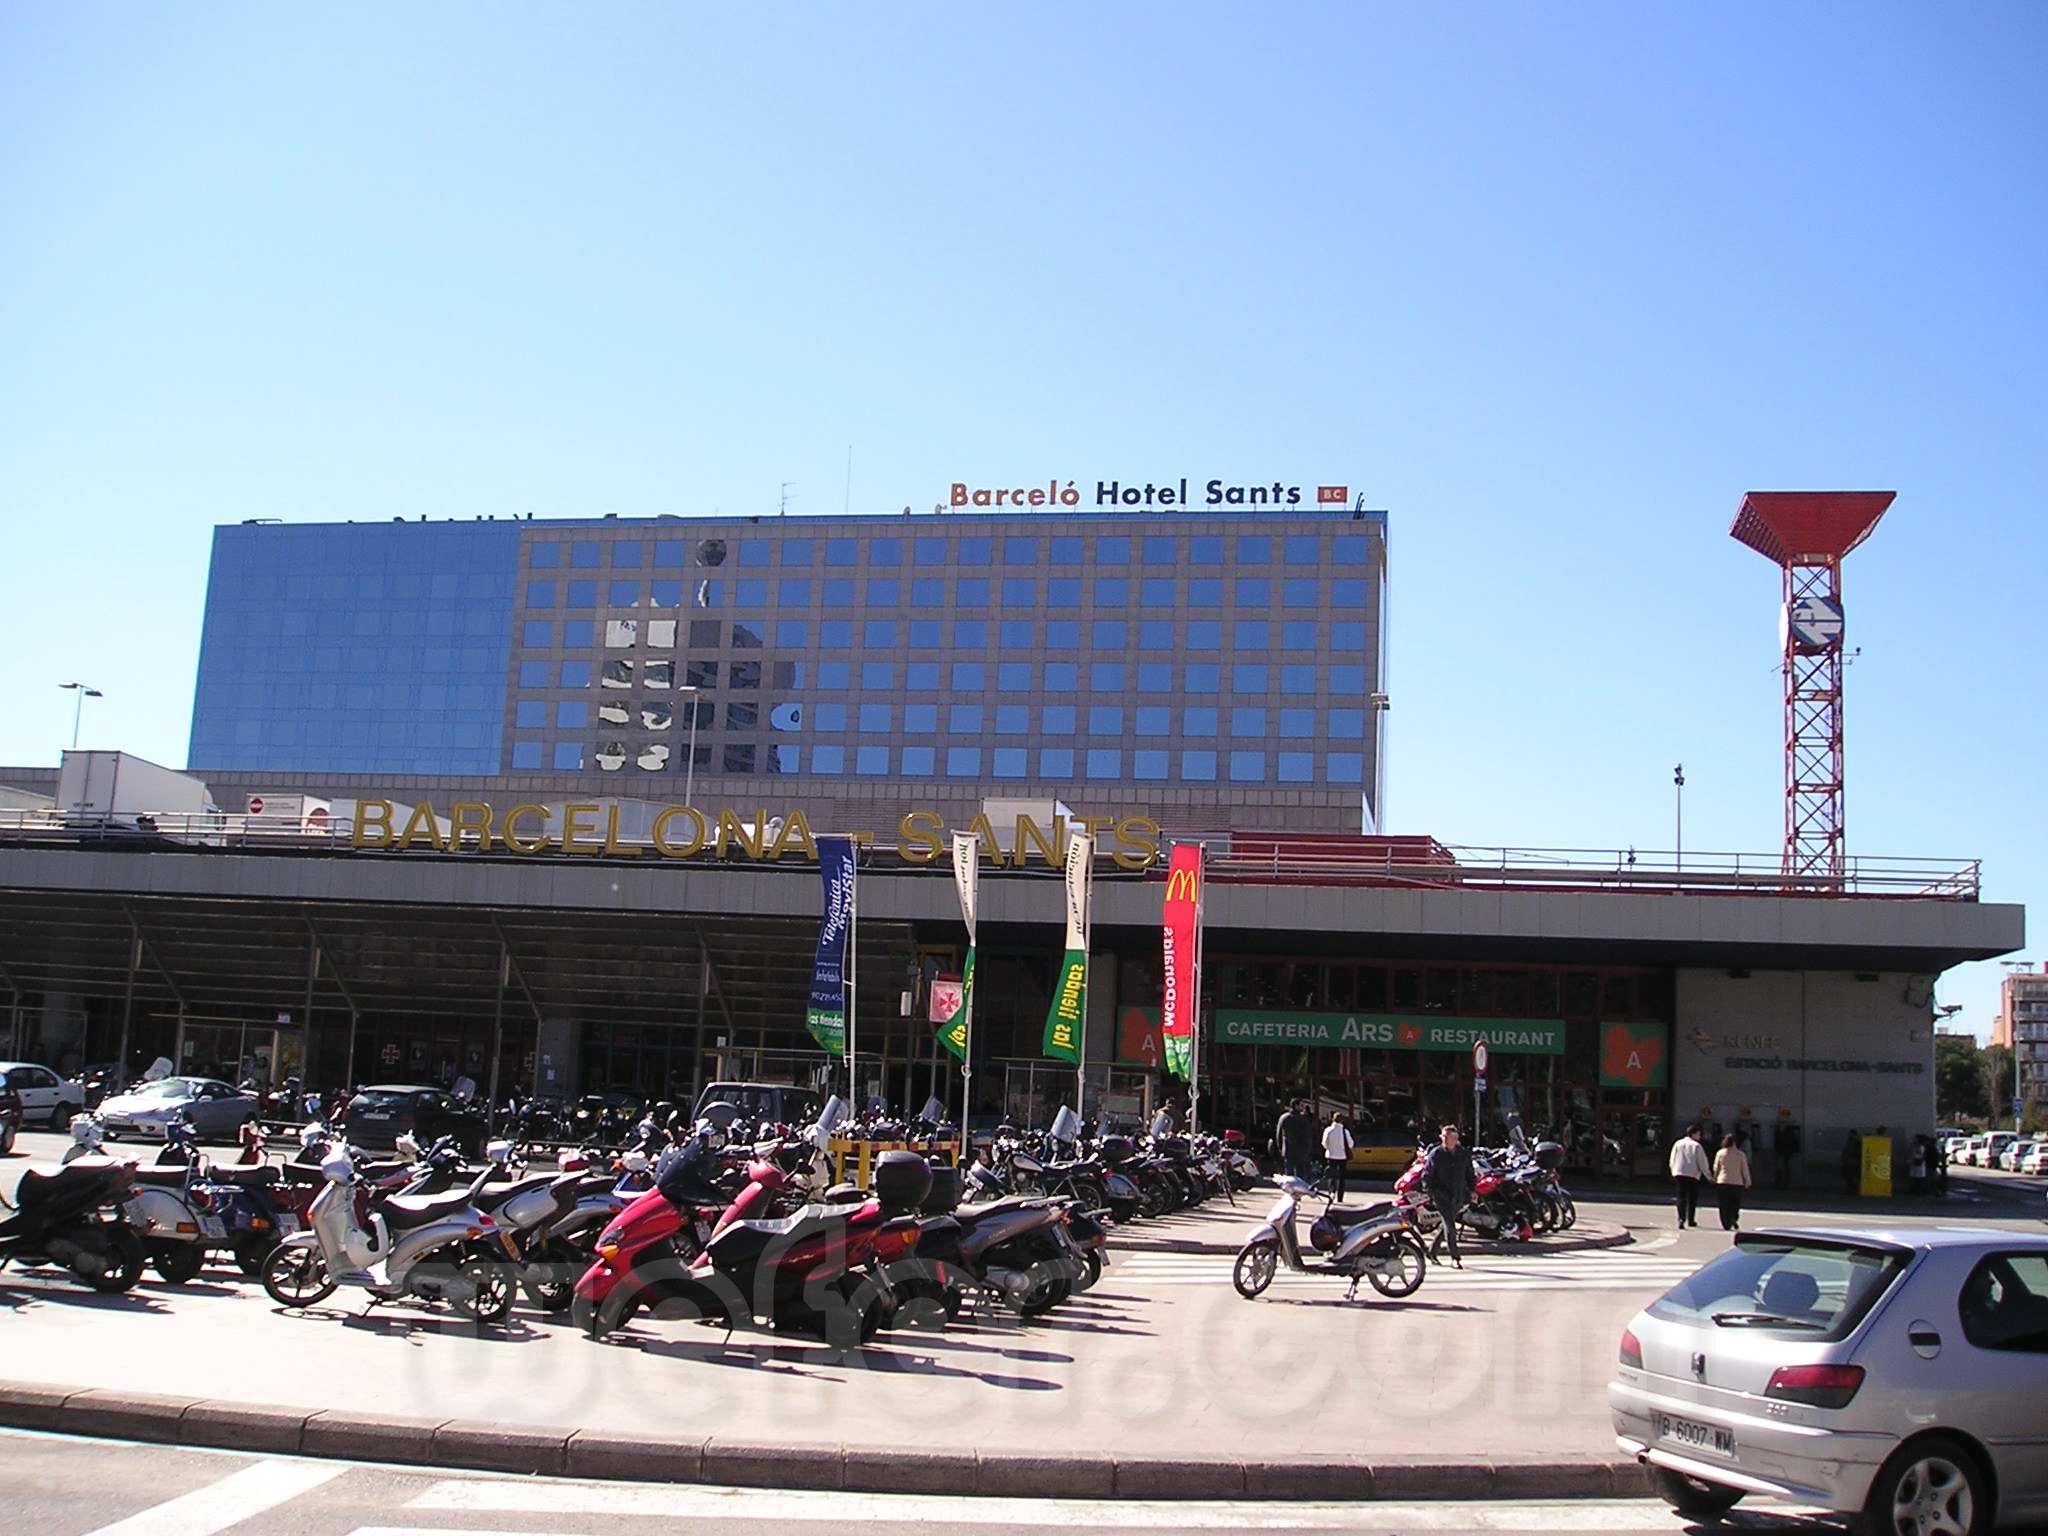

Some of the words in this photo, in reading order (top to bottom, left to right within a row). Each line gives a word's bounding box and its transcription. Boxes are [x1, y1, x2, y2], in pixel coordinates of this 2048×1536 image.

[951, 480, 1079, 506] Barceló
[1096, 478, 1187, 505] Hotel
[1205, 480, 1301, 504] Sants
[1323, 488, 1342, 500] BC
[352, 799, 819, 861] BARCELONA
[897, 809, 1160, 870] SANTS
[1140, 1033, 1156, 1052] A
[1226, 1021, 1330, 1039] CAFETERIA
[1430, 1028, 1555, 1046] RESTAURANT
[1625, 1050, 1642, 1070] A
